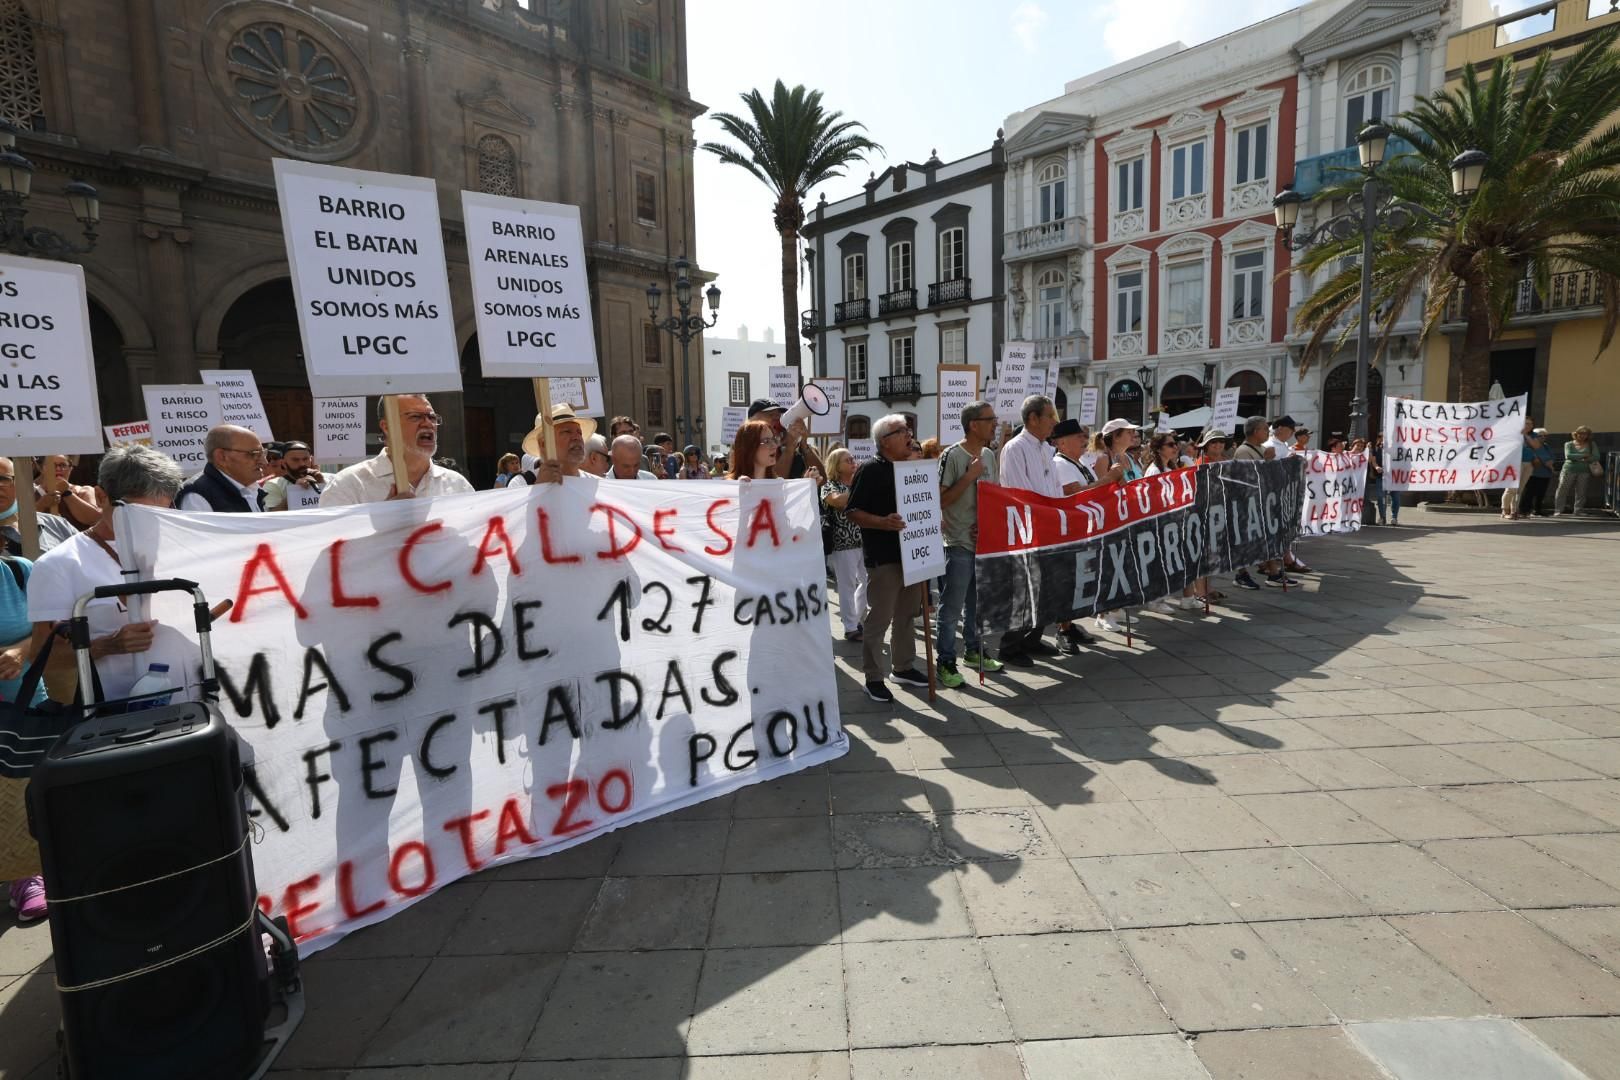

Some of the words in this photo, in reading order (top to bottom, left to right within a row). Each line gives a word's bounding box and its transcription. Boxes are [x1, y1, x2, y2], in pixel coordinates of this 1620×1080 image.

[319, 195, 405, 221] BARRIO
[492, 221, 555, 241] BARRIO
[314, 230, 341, 250] EL
[346, 233, 418, 255] BATAN
[484, 248, 569, 268] ARENALES
[327, 266, 416, 288] UNIDOS
[497, 276, 563, 294] UNIDOS
[0, 281, 18, 297] S
[310, 300, 389, 318] SOMOS
[394, 300, 439, 319] MÁS
[484, 302, 543, 318] SOMOS
[546, 304, 580, 319] MÁS
[342, 335, 409, 355] LPGC
[507, 330, 557, 348] LPGC
[1009, 351, 1026, 359] BARRIO
[17, 374, 60, 390] LAS
[162, 396, 203, 405] BARRIO
[220, 391, 253, 399] RENALES
[0, 405, 63, 421] RRES
[161, 412, 174, 420] EL
[176, 410, 208, 419] RISCO
[1396, 400, 1520, 420] ALCALDESA
[166, 424, 208, 434] UNIDOS
[1396, 426, 1494, 443] NUESTRO
[158, 439, 194, 448] SOMOS
[172, 452, 205, 462] LPGC
[1470, 446, 1495, 462] ES
[904, 474, 928, 486] BARRIO
[1392, 468, 1457, 484] NUESTRA
[904, 494, 912, 504] LA
[912, 491, 932, 503] ISLETA
[906, 510, 932, 522] UNIDOS
[1006, 470, 1195, 547] NINGUNA
[1310, 502, 1338, 520] LAS
[903, 530, 924, 542] SOMOS
[925, 526, 938, 536] MÁS
[229, 498, 799, 623] ALCALDESA.
[912, 546, 930, 560] LPGC
[199, 632, 416, 729] MAS
[448, 600, 550, 678] DE
[596, 575, 714, 642] 127
